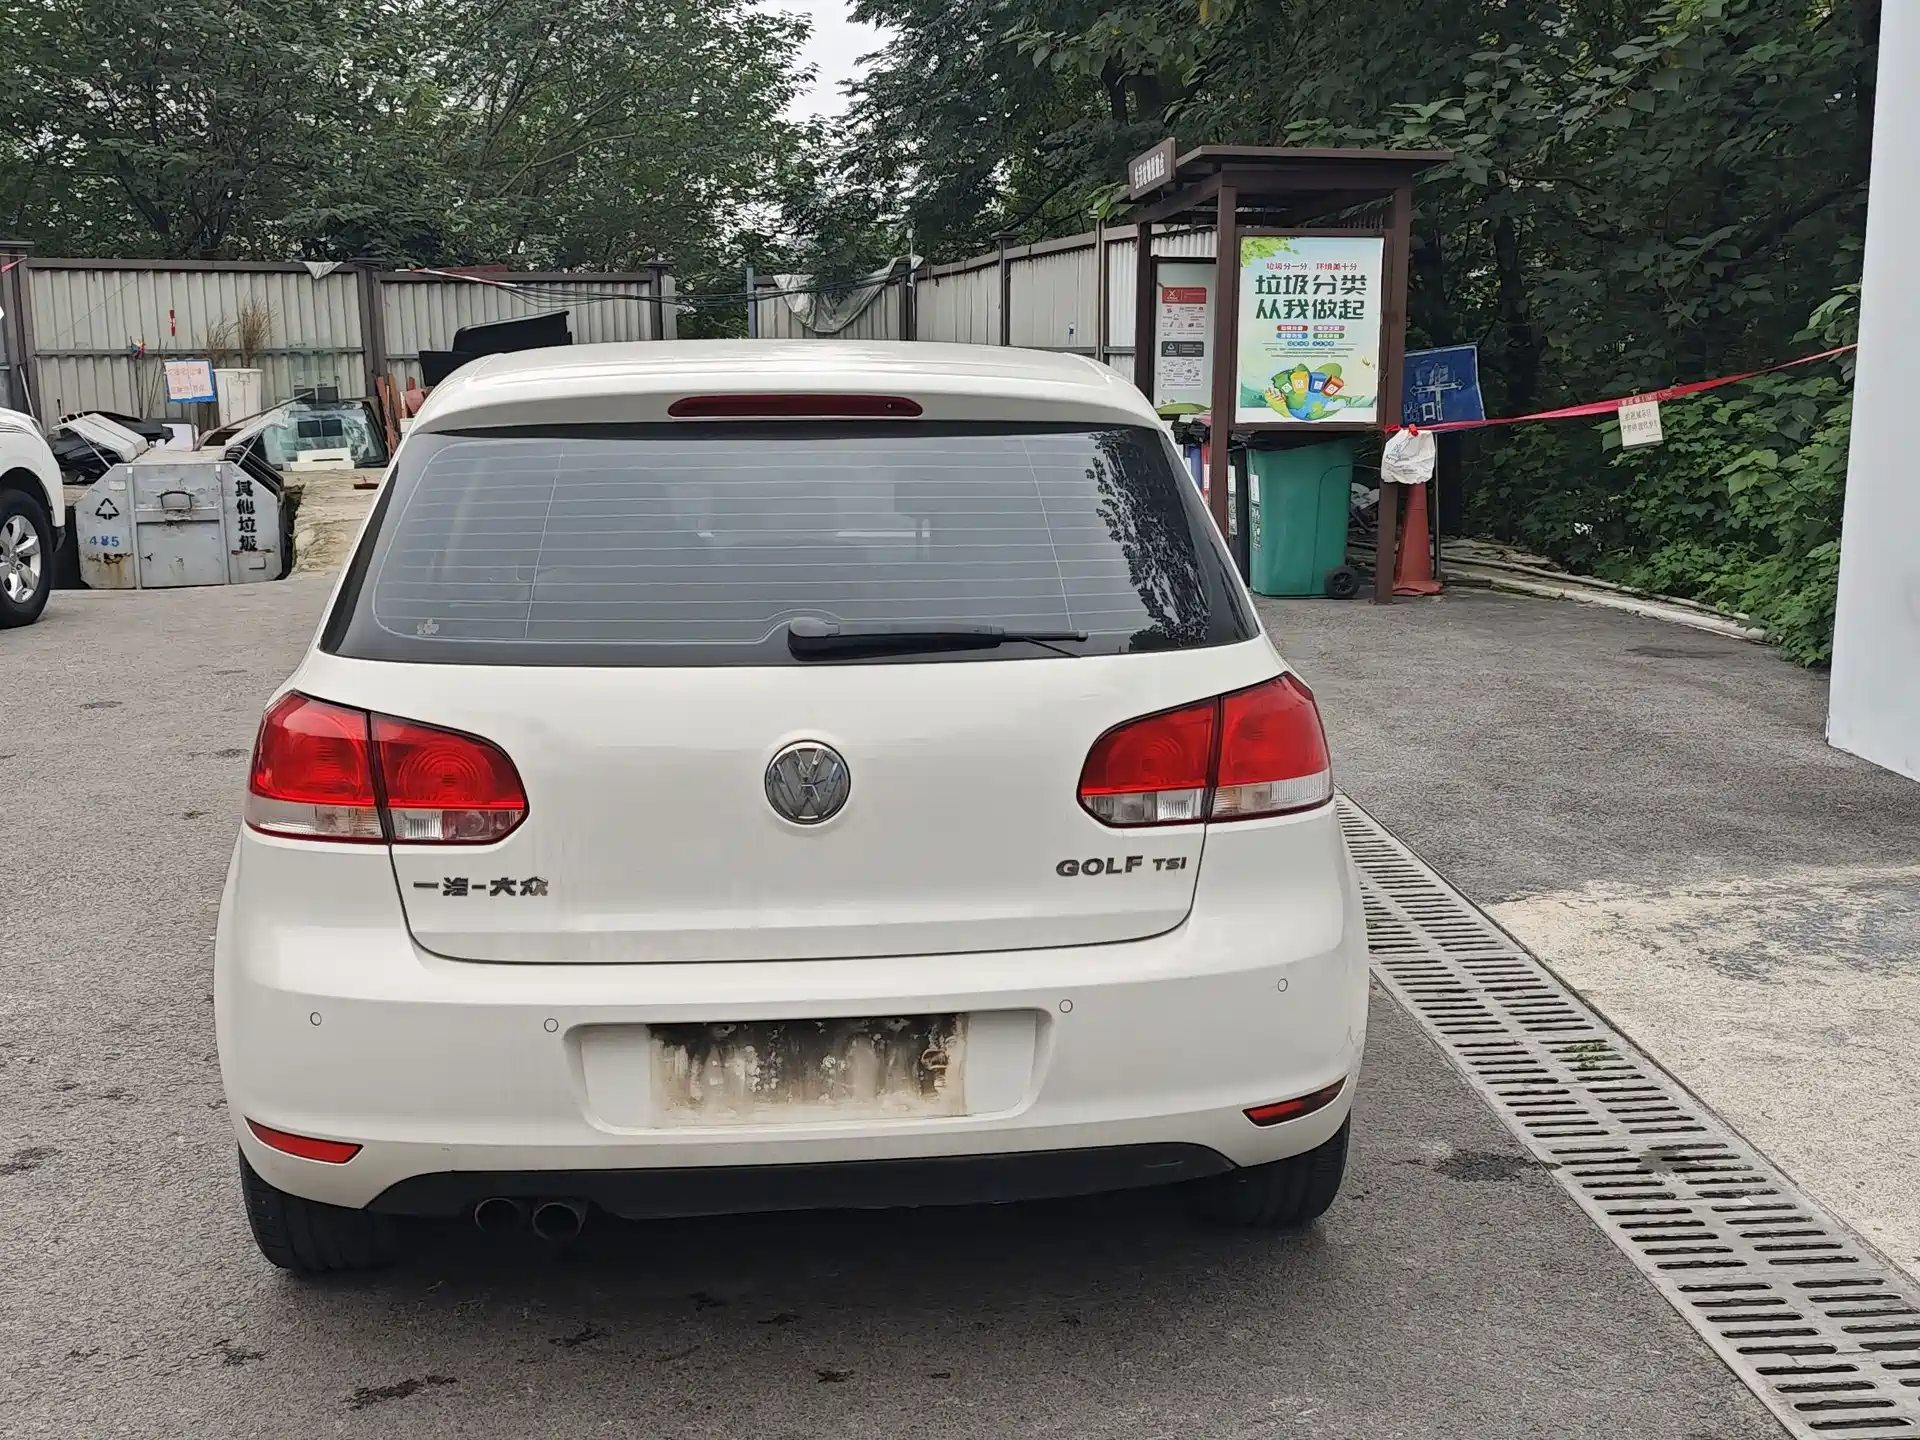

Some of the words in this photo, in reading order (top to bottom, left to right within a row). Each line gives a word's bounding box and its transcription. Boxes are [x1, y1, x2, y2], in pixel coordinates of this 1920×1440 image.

[1255, 274, 1367, 296] 垃圾分类
[1256, 298, 1365, 320] 从我做起
[235, 479, 258, 551] 其他垃圾
[89, 535, 120, 548] 485
[1056, 855, 1143, 877] GOLF
[1153, 856, 1187, 871] TSI
[413, 876, 548, 896] 一汽-大众
